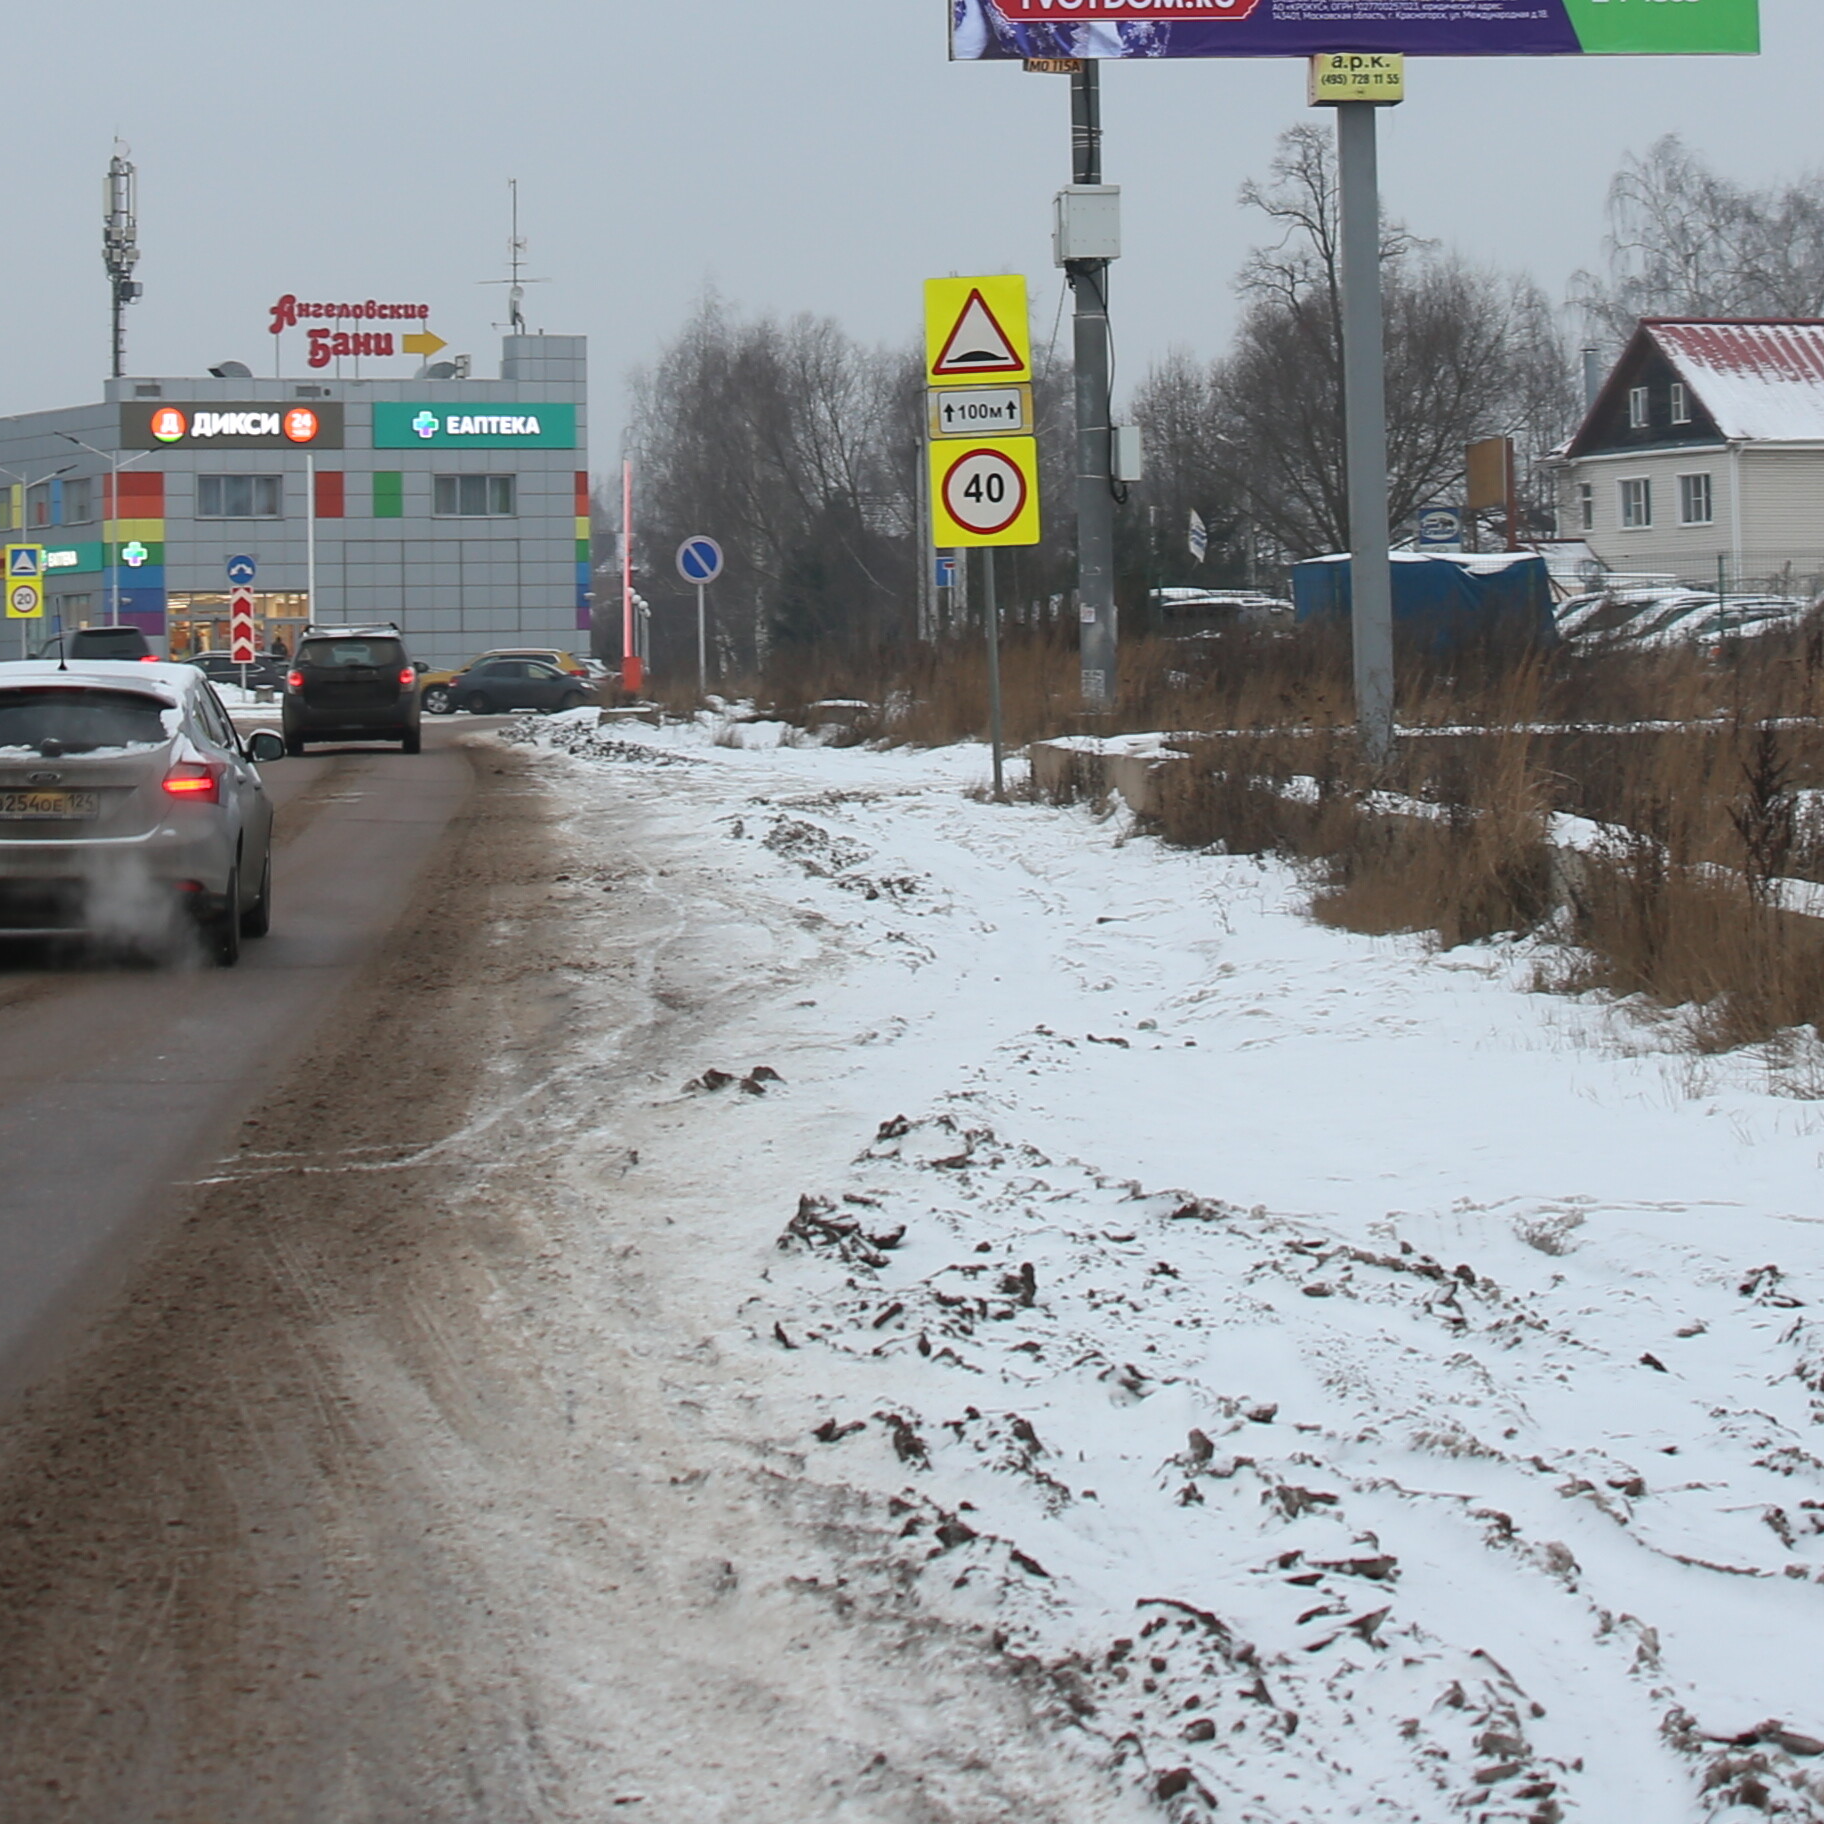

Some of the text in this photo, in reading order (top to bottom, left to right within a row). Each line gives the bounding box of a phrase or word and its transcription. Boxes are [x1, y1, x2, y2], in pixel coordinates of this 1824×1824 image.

[1331, 3, 1353, 11] ОГРН
[1321, 74, 1347, 85] (495)
[269, 294, 429, 334] Ангеловские
[307, 328, 394, 368] Бани
[958, 404, 1003, 419] 100м
[191, 412, 280, 437] ДИКСИ
[291, 413, 313, 428] 24
[446, 416, 541, 434] ЕАПТЕКА
[963, 473, 1005, 503] 40
[16, 592, 32, 606] 20
